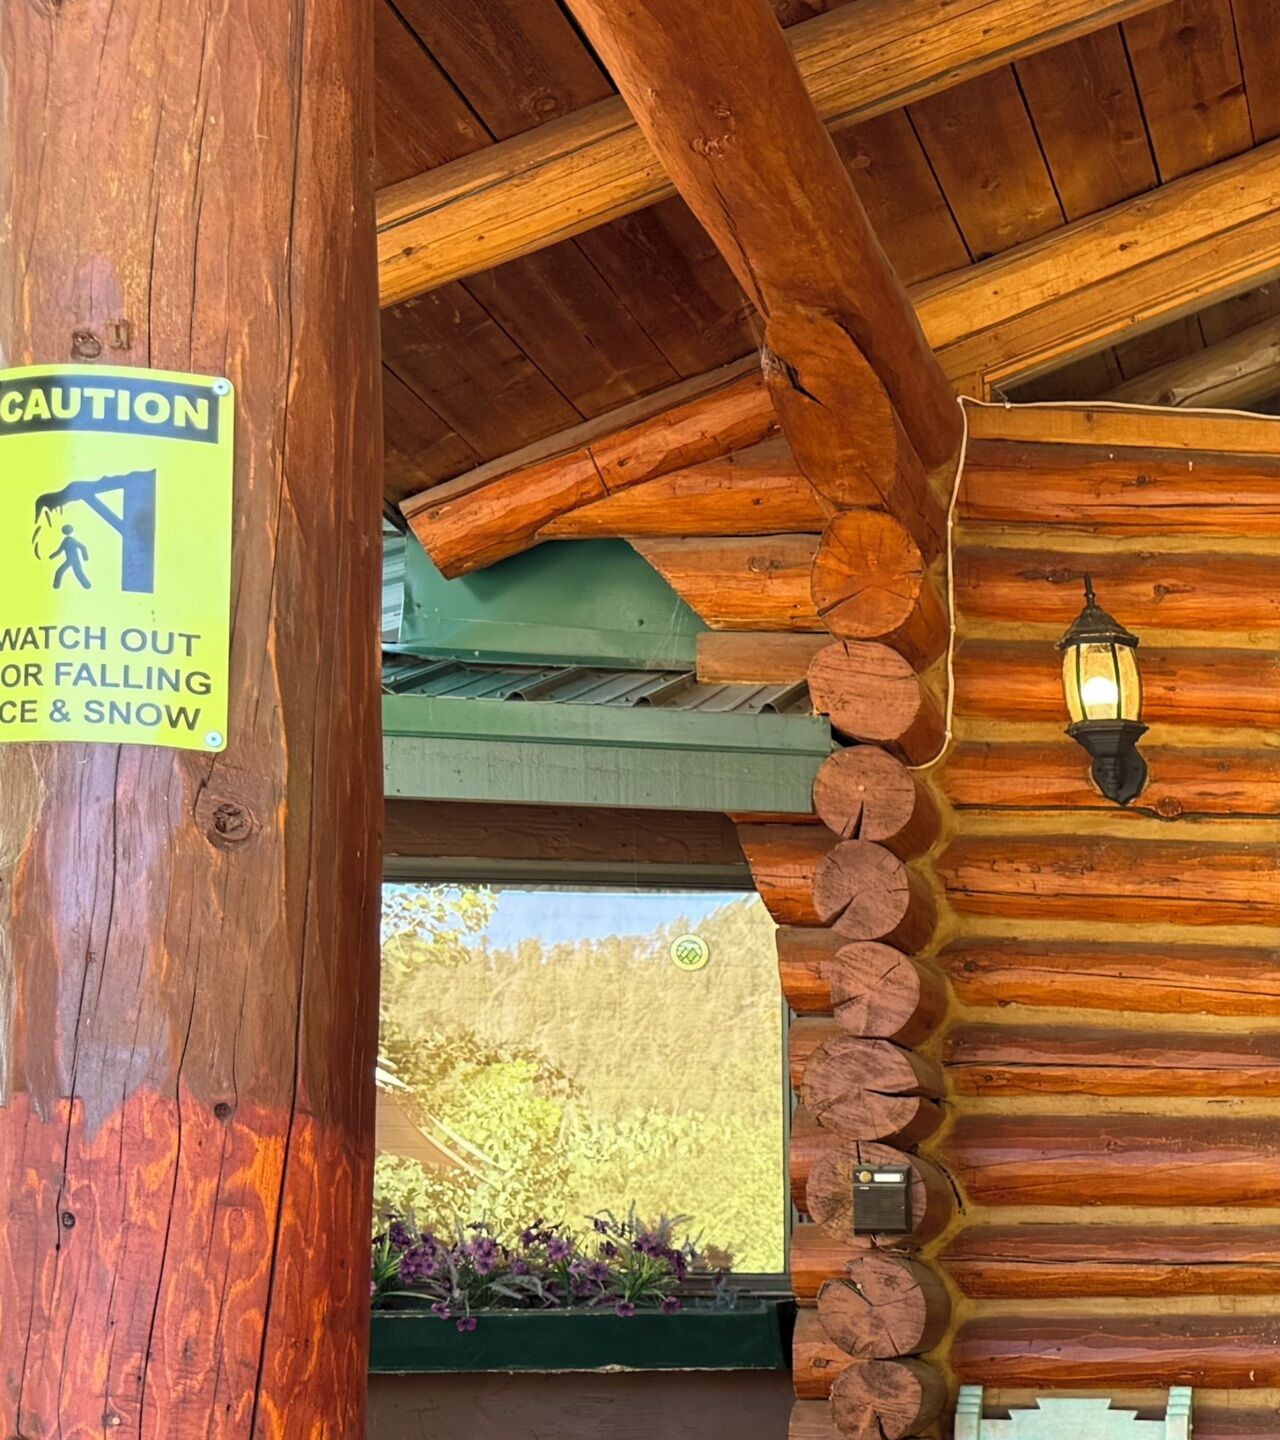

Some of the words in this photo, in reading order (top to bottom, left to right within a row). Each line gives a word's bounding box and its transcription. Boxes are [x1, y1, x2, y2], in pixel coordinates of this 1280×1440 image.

[0, 387, 209, 430] CAUTION
[0, 625, 106, 652] WATCH
[120, 628, 202, 657] OUT
[0, 663, 43, 688] OR
[55, 662, 212, 695] FALLING
[0, 699, 37, 723] CE
[49, 698, 71, 723] &
[83, 699, 202, 731] SNOW
